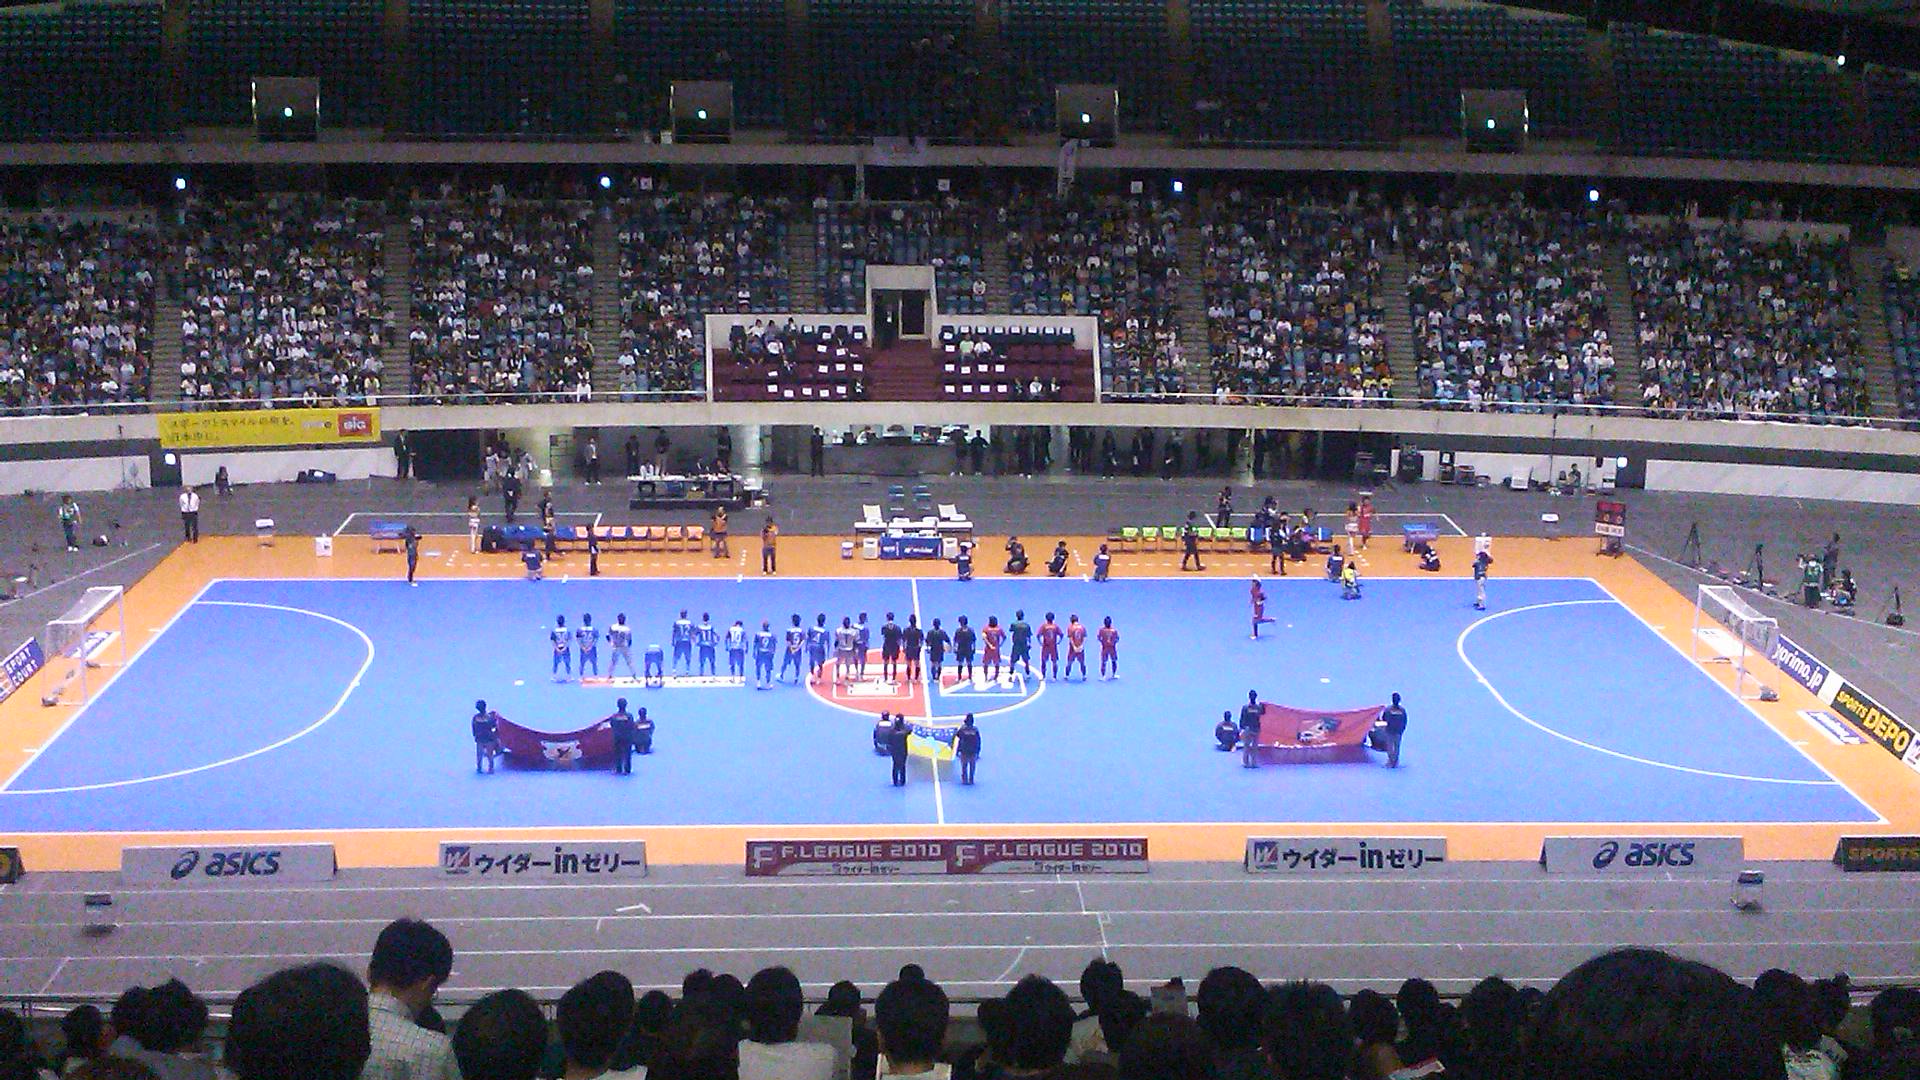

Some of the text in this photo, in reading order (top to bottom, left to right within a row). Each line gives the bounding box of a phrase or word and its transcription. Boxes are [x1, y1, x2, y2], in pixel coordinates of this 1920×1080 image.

[4, 646, 33, 674] SPORT
[11, 658, 39, 686] COURT
[1836, 690, 1868, 719] SPORTS
[1863, 706, 1911, 753] DEPO
[205, 850, 281, 877] asics
[781, 843, 941, 858] F.LEAGUE 2010
[983, 843, 1142, 857] F.LEAGUE 2010
[1624, 842, 1696, 867] asics
